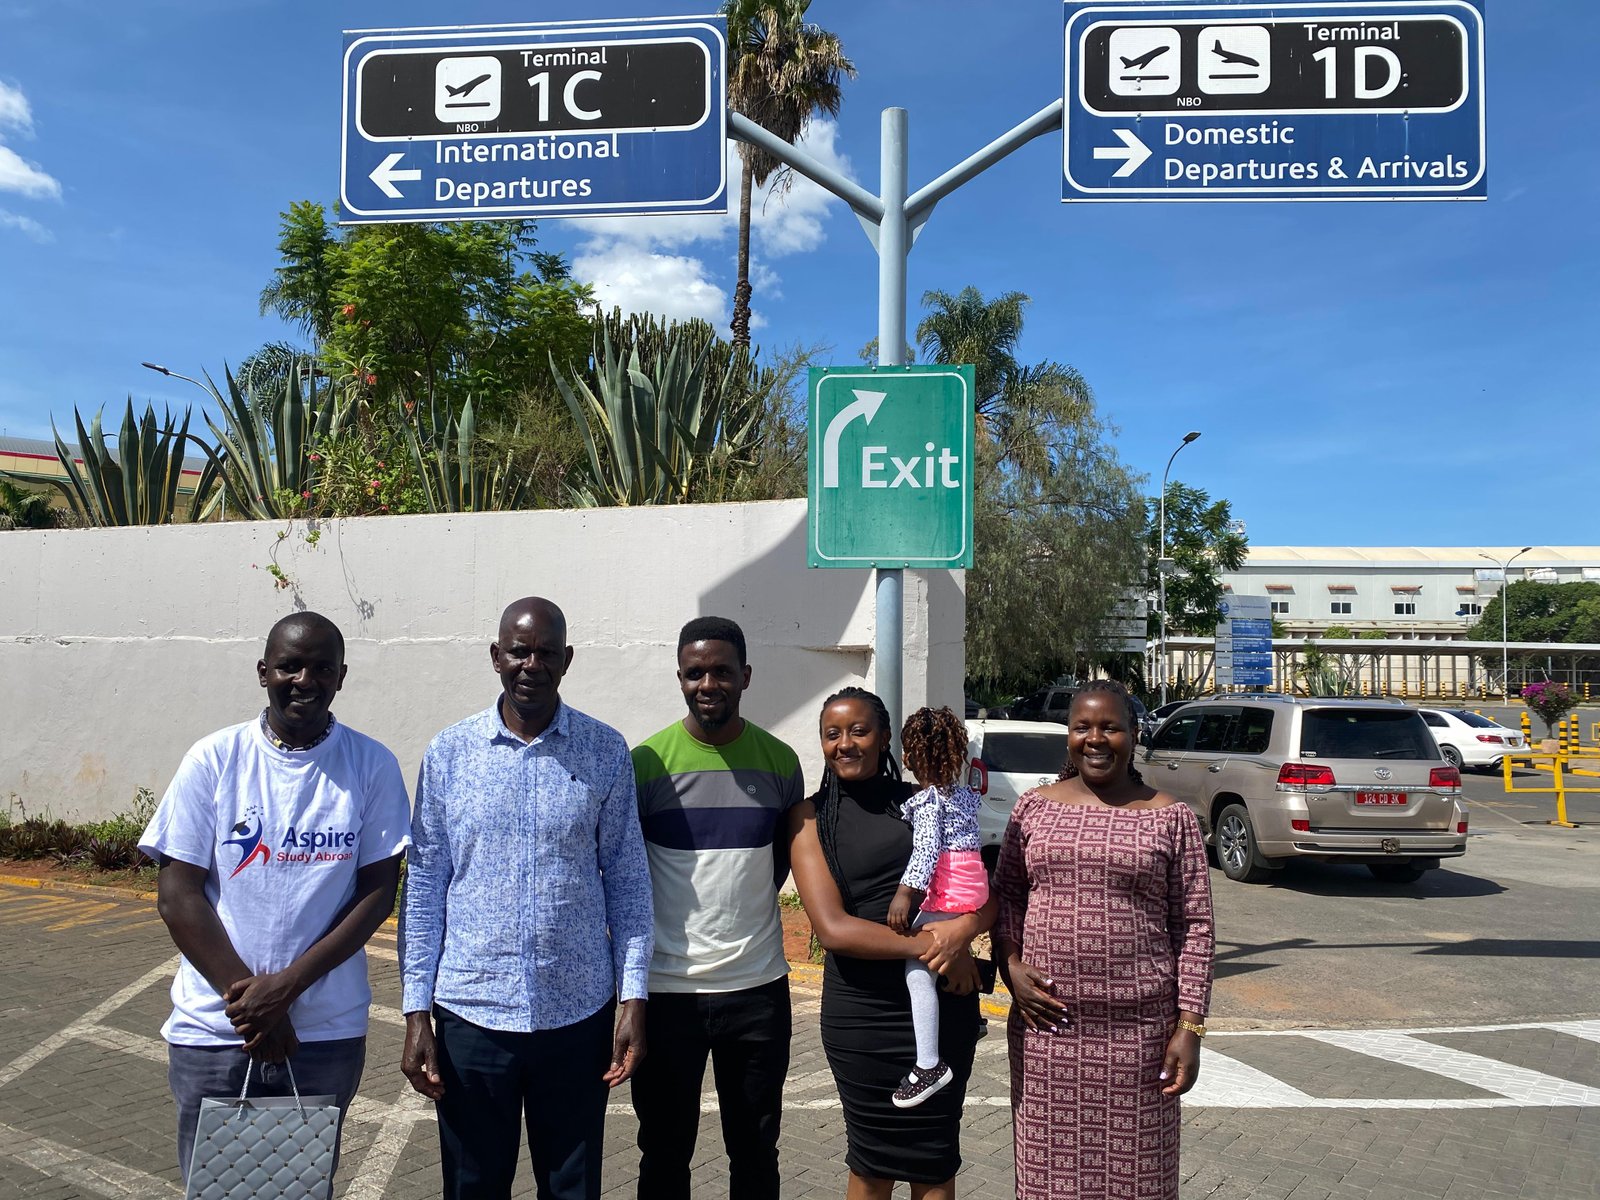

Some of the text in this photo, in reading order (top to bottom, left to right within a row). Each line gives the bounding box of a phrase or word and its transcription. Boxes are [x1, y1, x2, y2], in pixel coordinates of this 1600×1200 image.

[1304, 21, 1400, 41] Terminal
[520, 46, 607, 68] Terminal
[1312, 46, 1402, 100] 1D
[527, 70, 603, 122] 1C
[1176, 97, 1202, 107] NBO
[456, 123, 479, 133] NBO
[1165, 121, 1294, 145] Domestic
[436, 133, 620, 164] International
[1165, 154, 1468, 185] Departures & Arrivals
[435, 176, 592, 207] Departures
[862, 442, 960, 489] Exit
[1364, 793, 1376, 804] 124
[1379, 793, 1388, 804] CD
[281, 826, 355, 853] Aspire
[277, 850, 353, 864] Study Abroad
